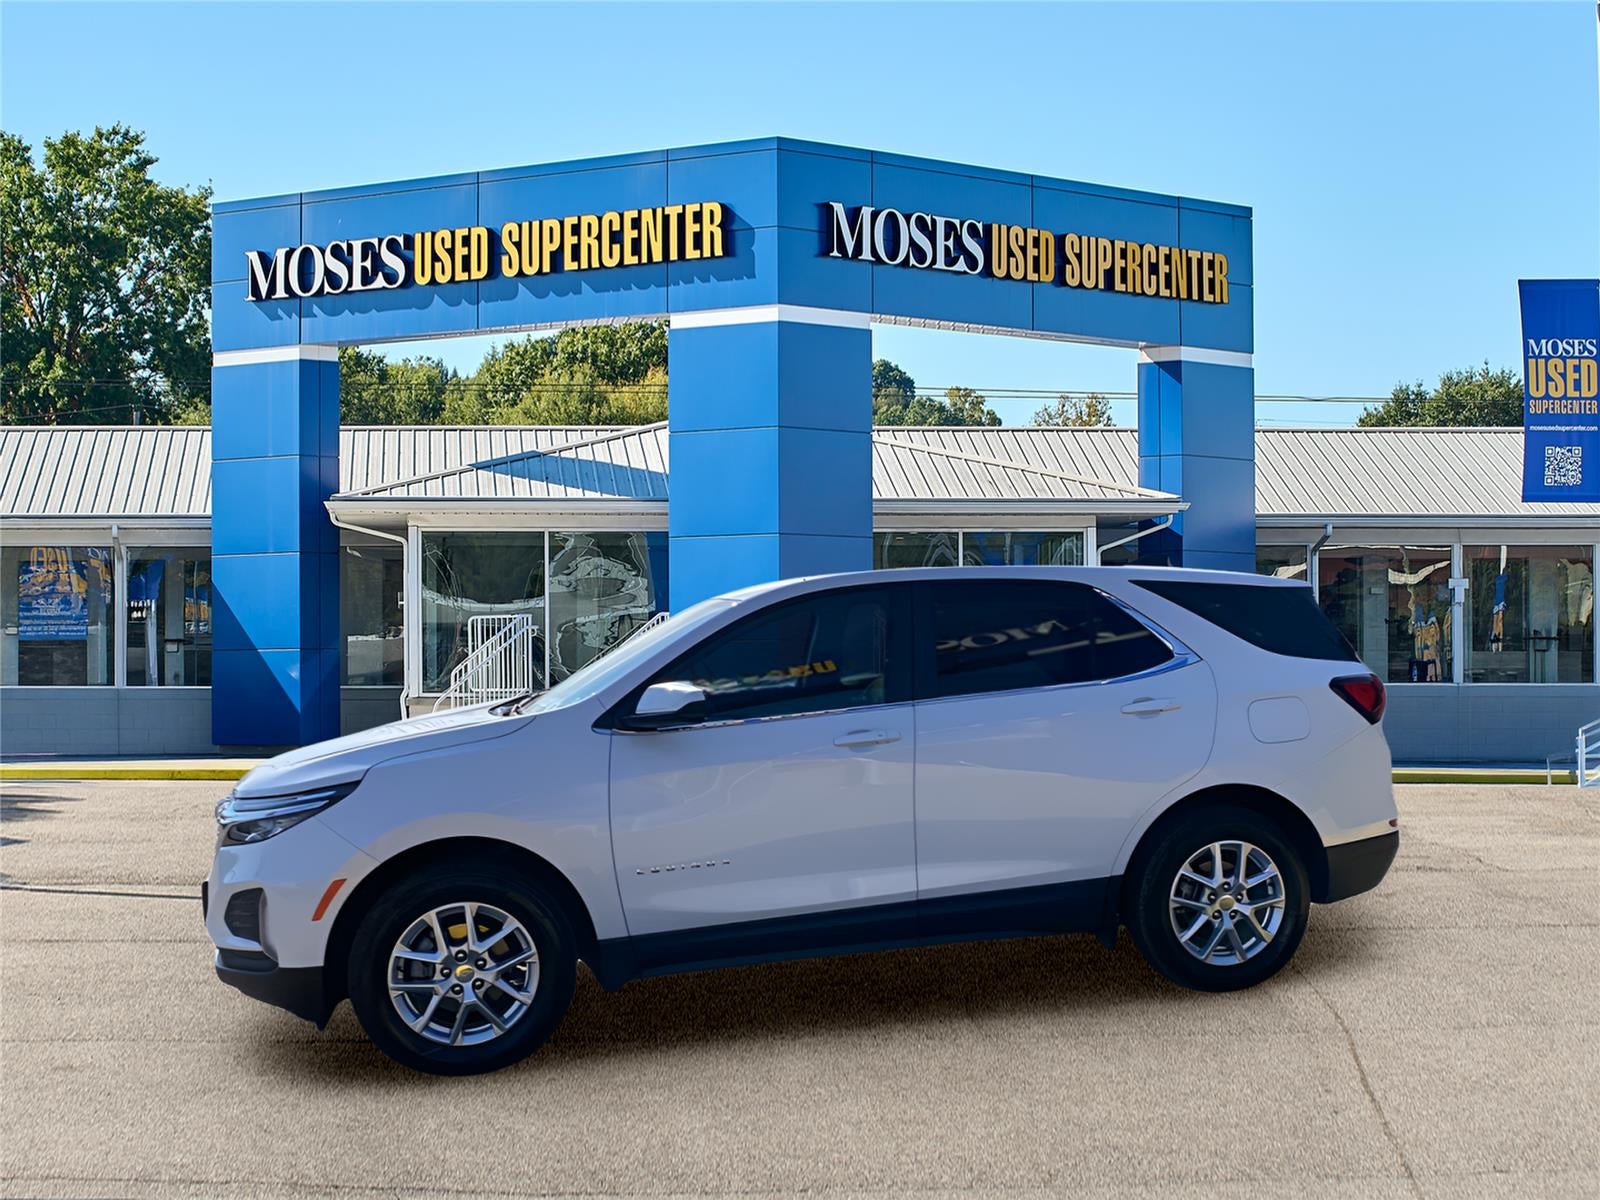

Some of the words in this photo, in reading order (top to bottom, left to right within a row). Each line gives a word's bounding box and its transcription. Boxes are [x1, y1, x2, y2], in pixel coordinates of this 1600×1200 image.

[244, 235, 407, 302] MOSES
[413, 226, 489, 286] USED
[500, 201, 724, 278] SUPERCENTER
[828, 201, 985, 275] MOSES
[991, 223, 1056, 283] USED
[1065, 233, 1230, 304] SUPERCENTER
[1527, 338, 1598, 357] MOSES
[1528, 358, 1598, 398] USED
[1529, 400, 1598, 414] SUPERCENTER
